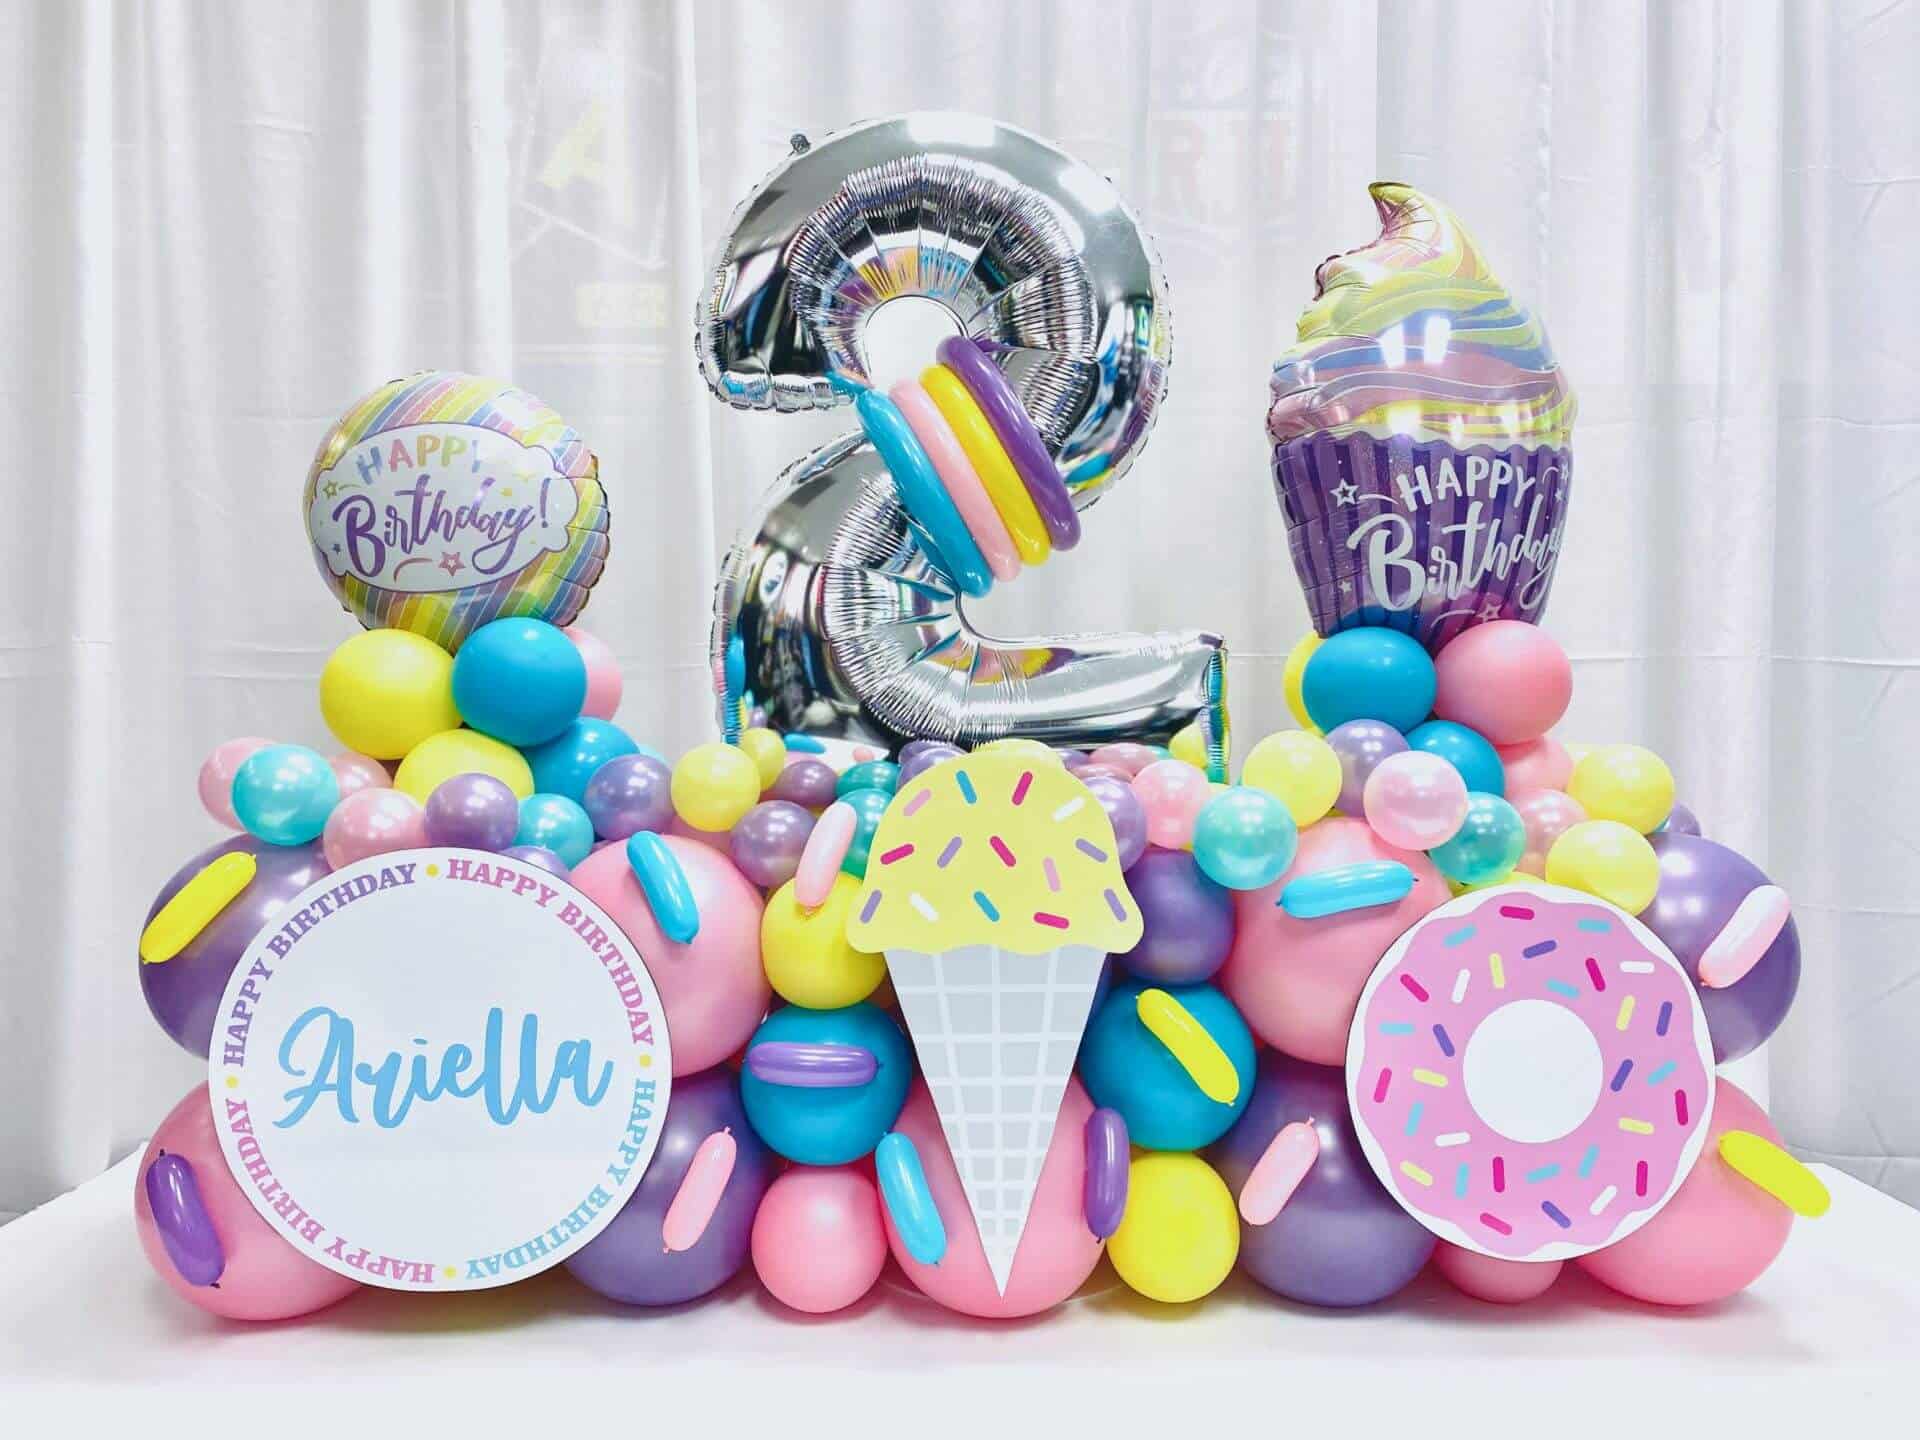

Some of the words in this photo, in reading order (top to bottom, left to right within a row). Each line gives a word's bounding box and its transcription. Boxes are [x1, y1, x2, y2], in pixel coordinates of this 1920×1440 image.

[697, 112, 1227, 780] 2
[1396, 456, 1536, 512] HAPPY
[332, 473, 549, 577] Birthday!
[1346, 494, 1564, 612] Birthday
[223, 958, 273, 1067] HAPPY
[266, 863, 417, 960] BIRTHDAY
[447, 858, 559, 908] HAPPY
[557, 900, 654, 1046] BIRTHDAY
[272, 1006, 614, 1129] Ariella
[225, 1098, 326, 1244] BIRTHDAY
[607, 1078, 657, 1187] HAPPY
[325, 1236, 435, 1284] HAPPY
[465, 1183, 614, 1281] BIRTHDAY
